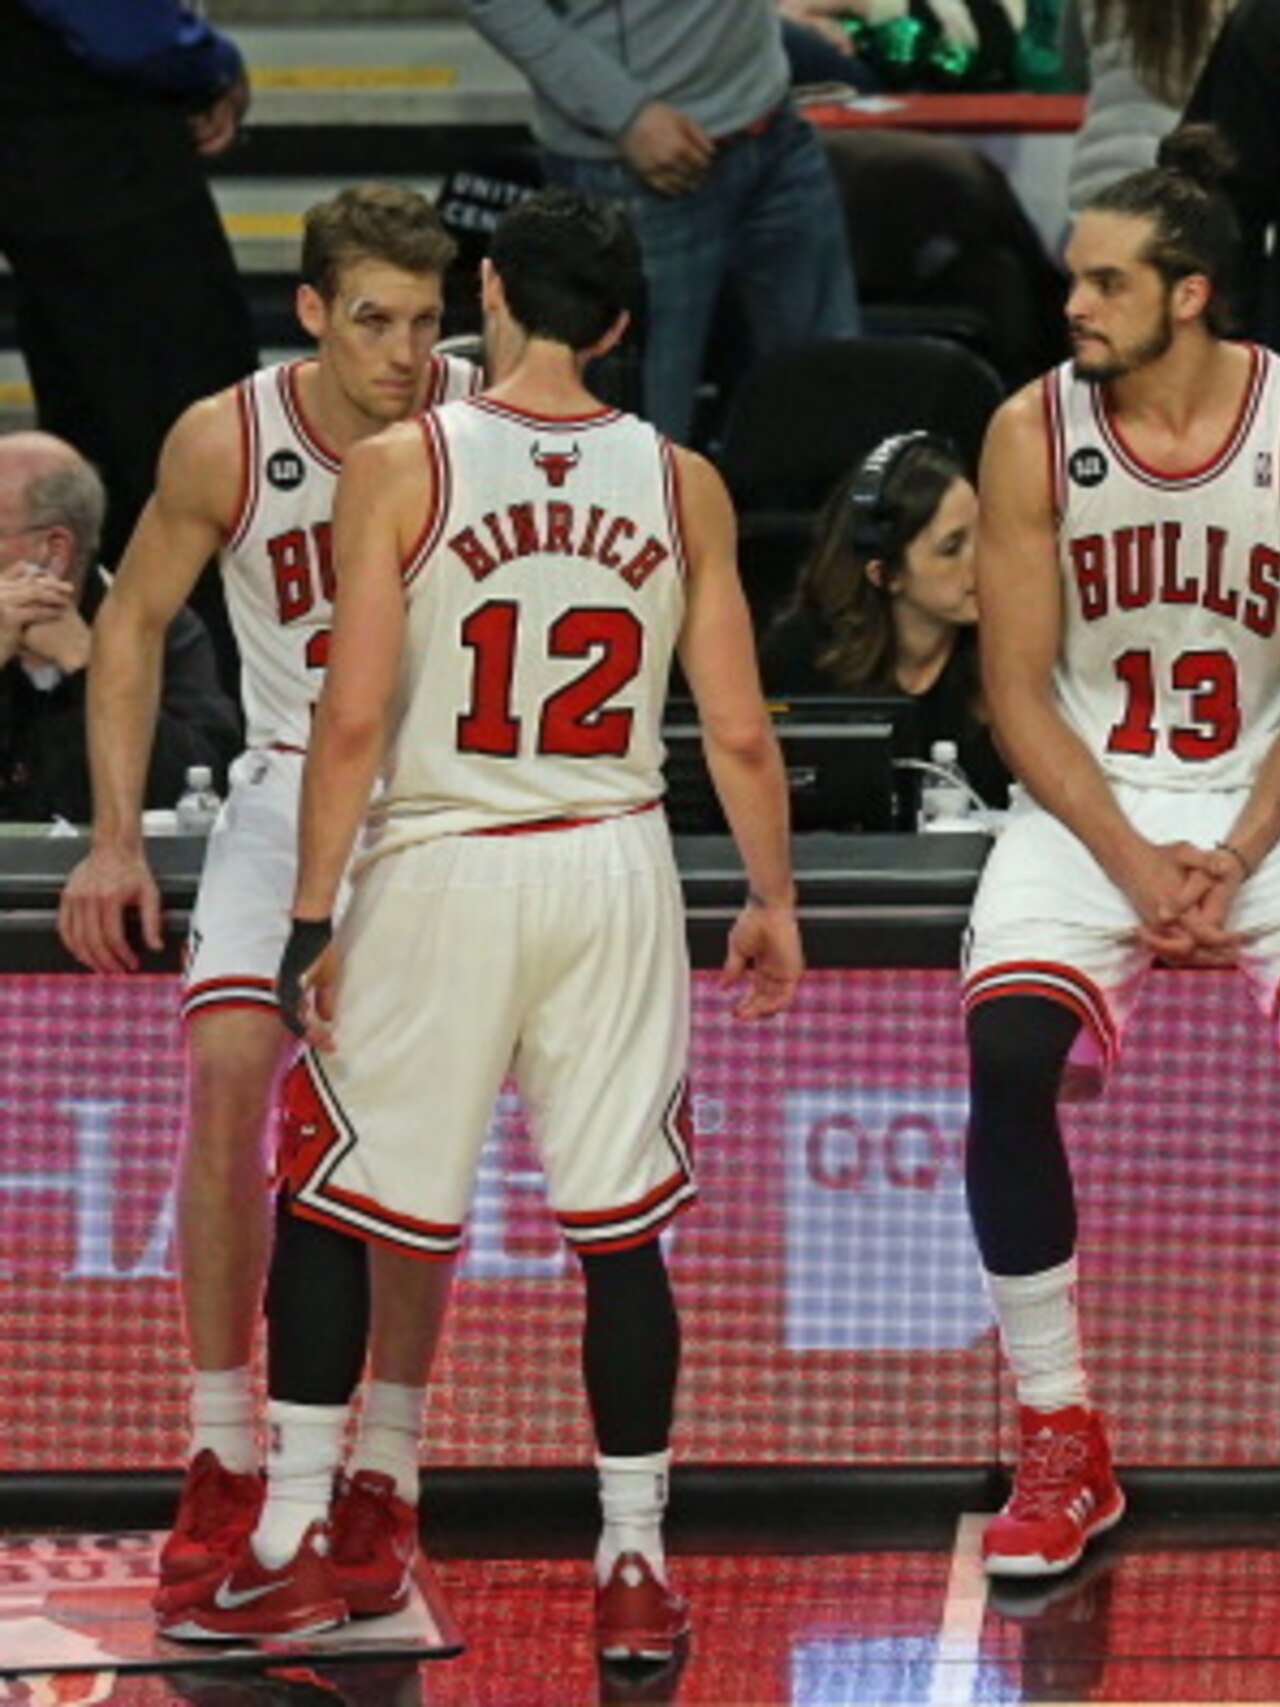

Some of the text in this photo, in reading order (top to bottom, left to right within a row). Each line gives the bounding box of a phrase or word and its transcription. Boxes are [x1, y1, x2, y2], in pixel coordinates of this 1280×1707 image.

[443, 200, 499, 232] CEN
[447, 501, 669, 590] HINRICH
[457, 599, 644, 758] 12
[1105, 648, 1242, 763] 13
